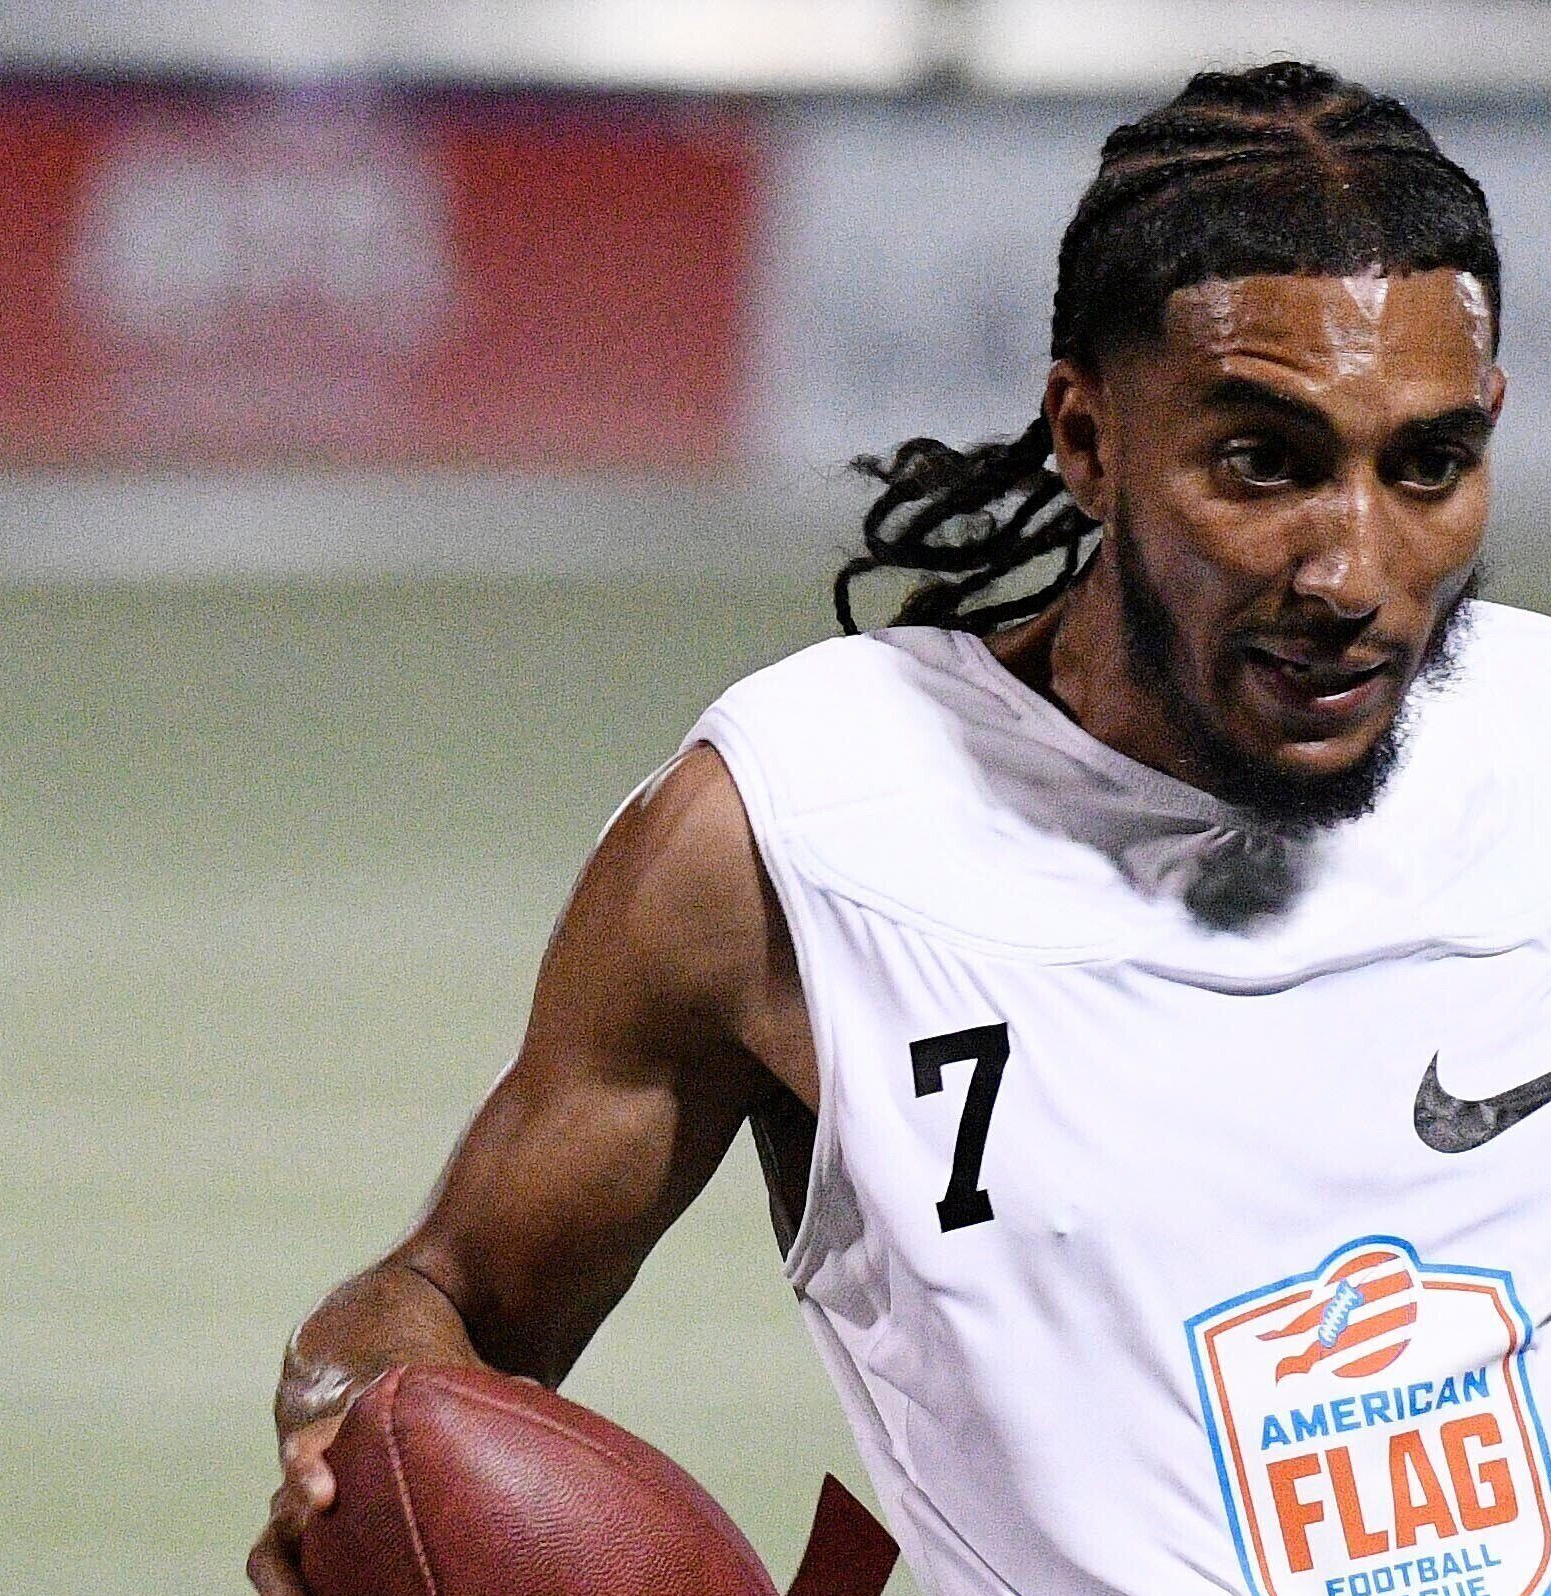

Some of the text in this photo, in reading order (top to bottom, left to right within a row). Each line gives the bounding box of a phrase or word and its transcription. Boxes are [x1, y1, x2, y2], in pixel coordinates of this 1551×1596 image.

[909, 1021, 1011, 1234] 7
[1259, 1366, 1491, 1451] AMERICAN
[1266, 1411, 1519, 1574] FLAG
